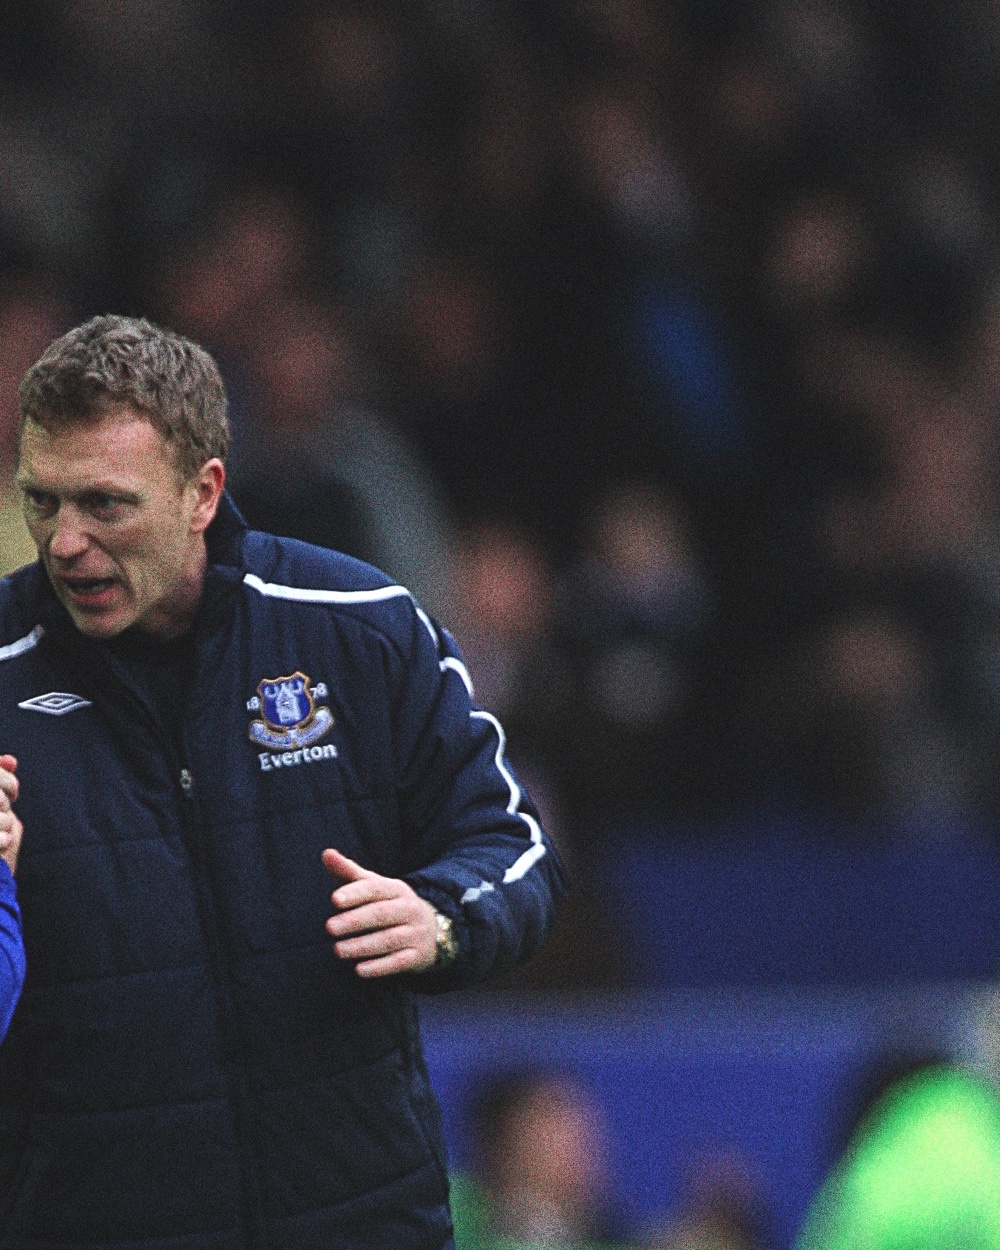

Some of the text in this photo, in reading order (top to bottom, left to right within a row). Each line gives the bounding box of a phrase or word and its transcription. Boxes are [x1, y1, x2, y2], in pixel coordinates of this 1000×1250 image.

[246, 682, 328, 711] 18 78
[258, 744, 337, 771] Everton
